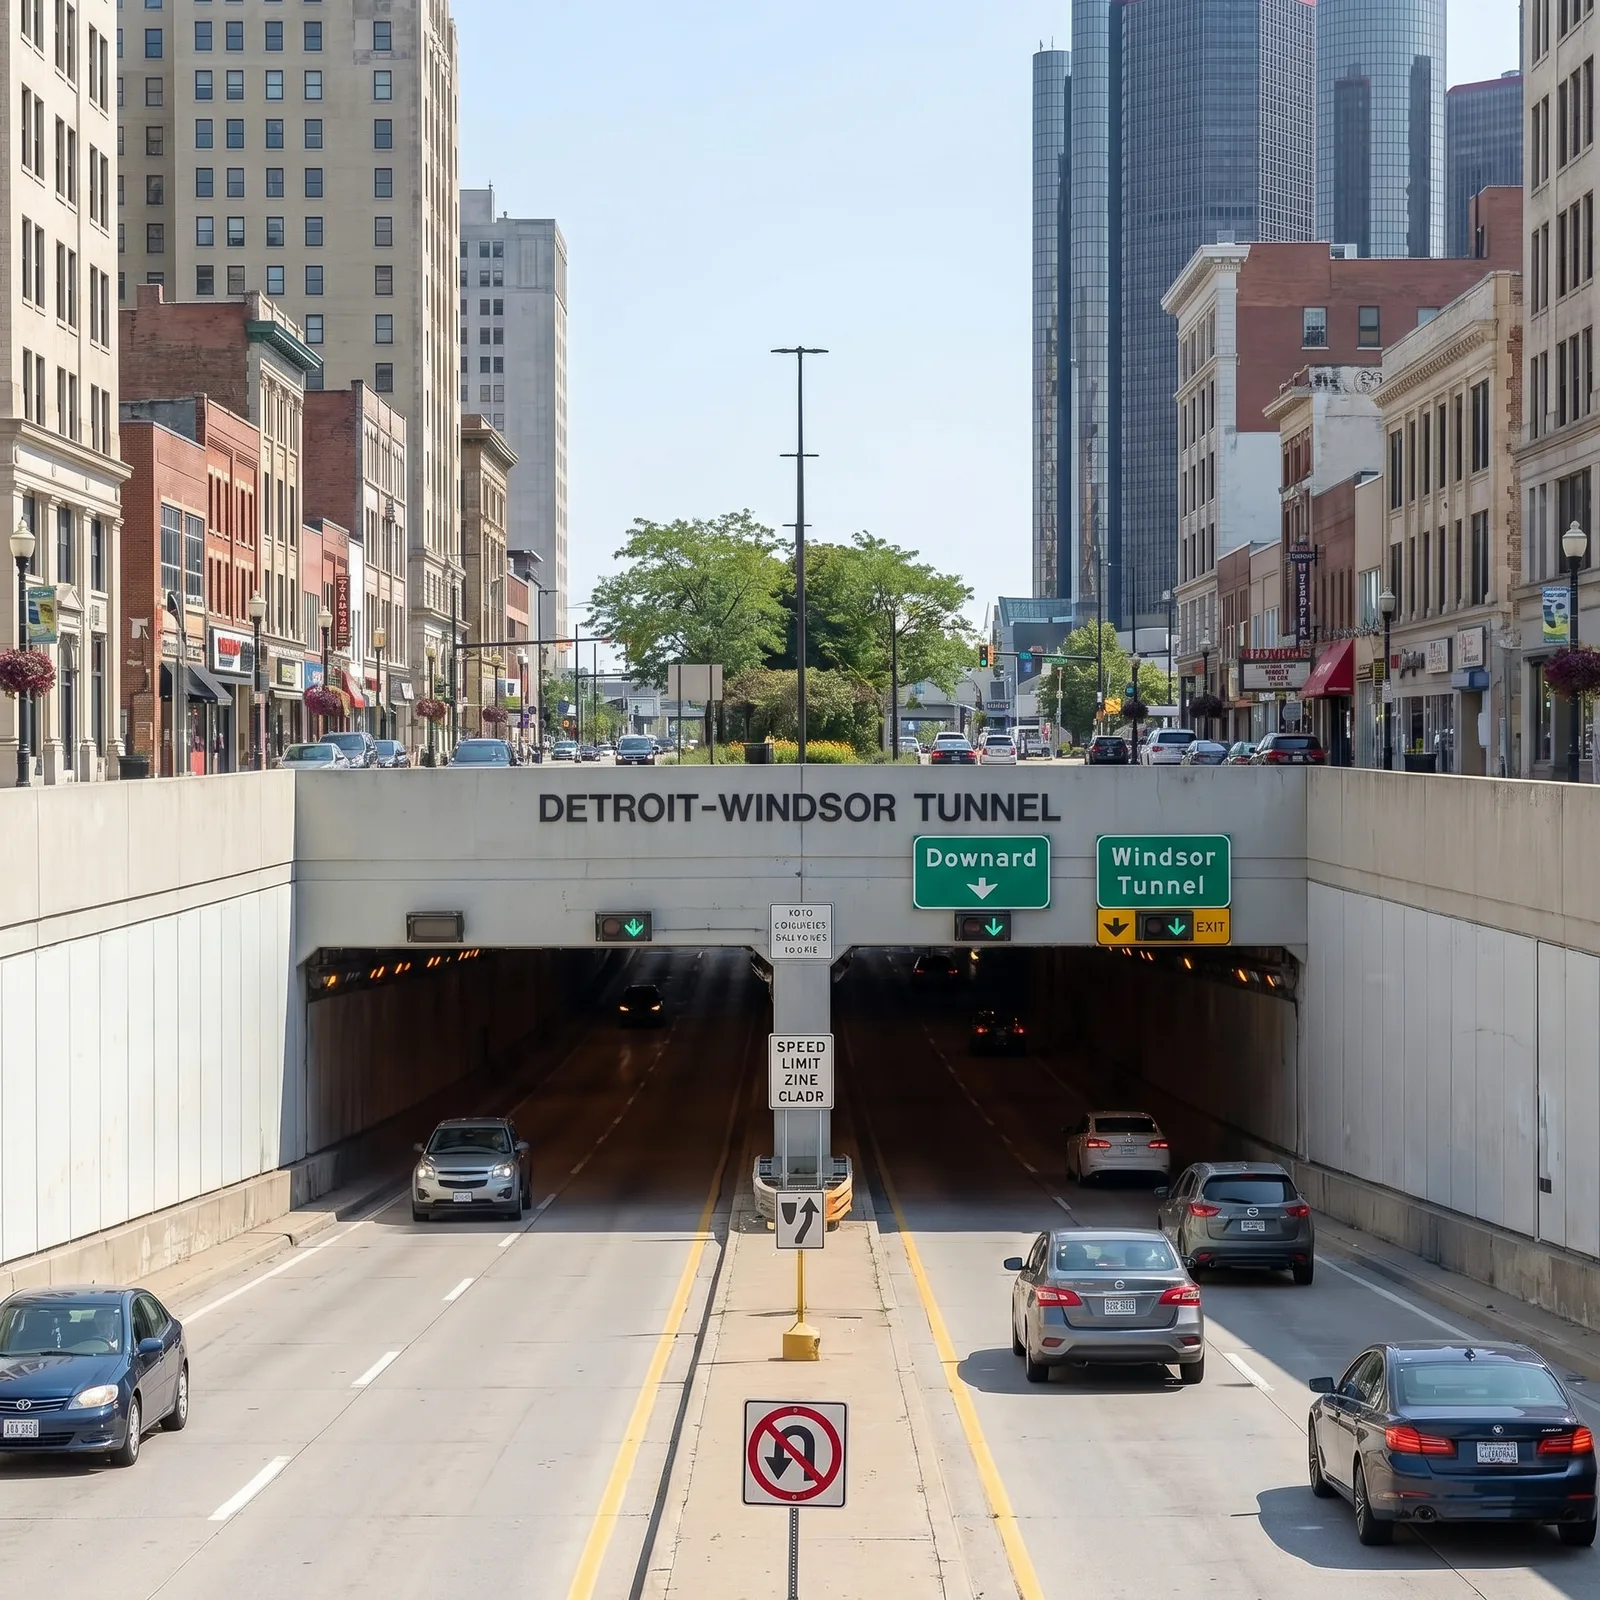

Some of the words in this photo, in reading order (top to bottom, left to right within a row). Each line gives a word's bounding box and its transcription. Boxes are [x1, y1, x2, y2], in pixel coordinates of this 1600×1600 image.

[539, 793, 896, 823] DETROIT-WINDSOR
[914, 793, 1061, 822] TUNNEL
[926, 848, 1036, 867] Downard
[1112, 847, 1216, 866] Windsor
[1117, 876, 1204, 895] Tunnel
[1196, 921, 1226, 933] EXIT
[777, 1041, 826, 1053] SPEED
[782, 1058, 821, 1070] LIMIT
[784, 1074, 819, 1086] ZINE
[778, 1091, 824, 1102] CLADR
